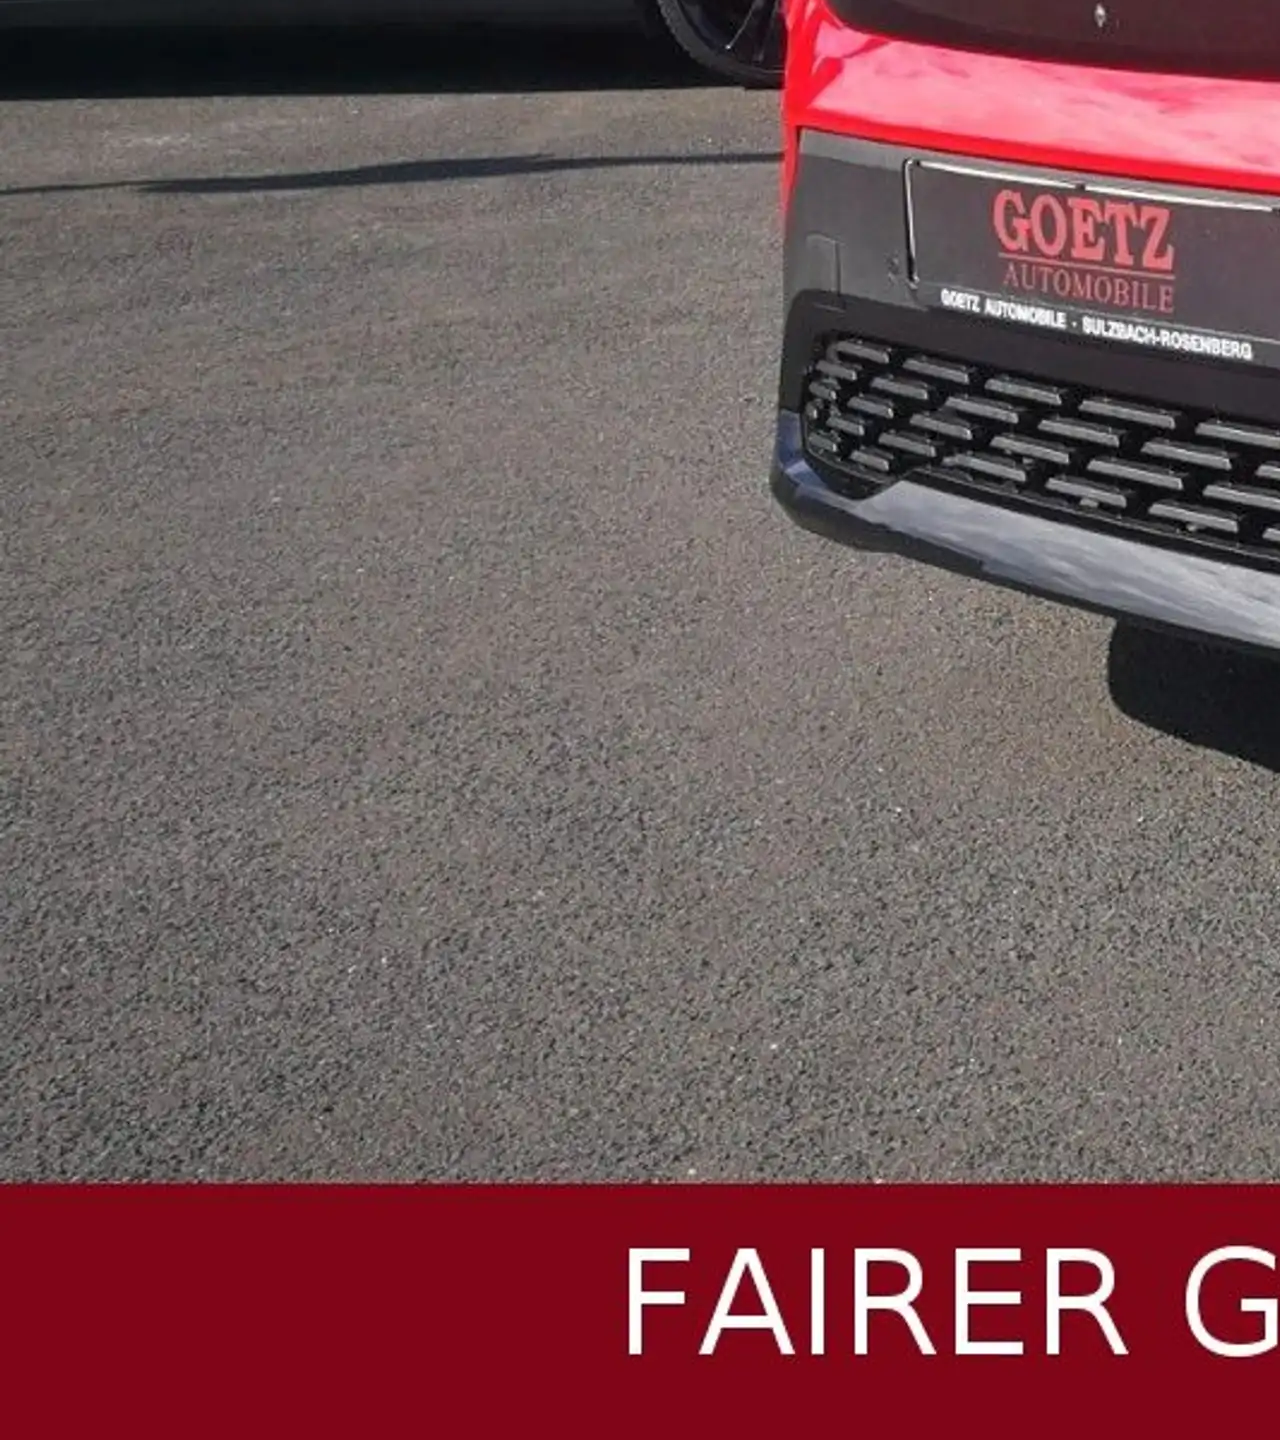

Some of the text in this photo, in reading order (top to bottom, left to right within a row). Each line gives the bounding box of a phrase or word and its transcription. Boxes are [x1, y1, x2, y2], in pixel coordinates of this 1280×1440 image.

[992, 189, 1176, 271] GOETZ
[940, 288, 1254, 361] GOETZ AUTOMOBILE SULZBACH-ROSENBERG
[1002, 263, 1176, 314] AUTOMOBILE
